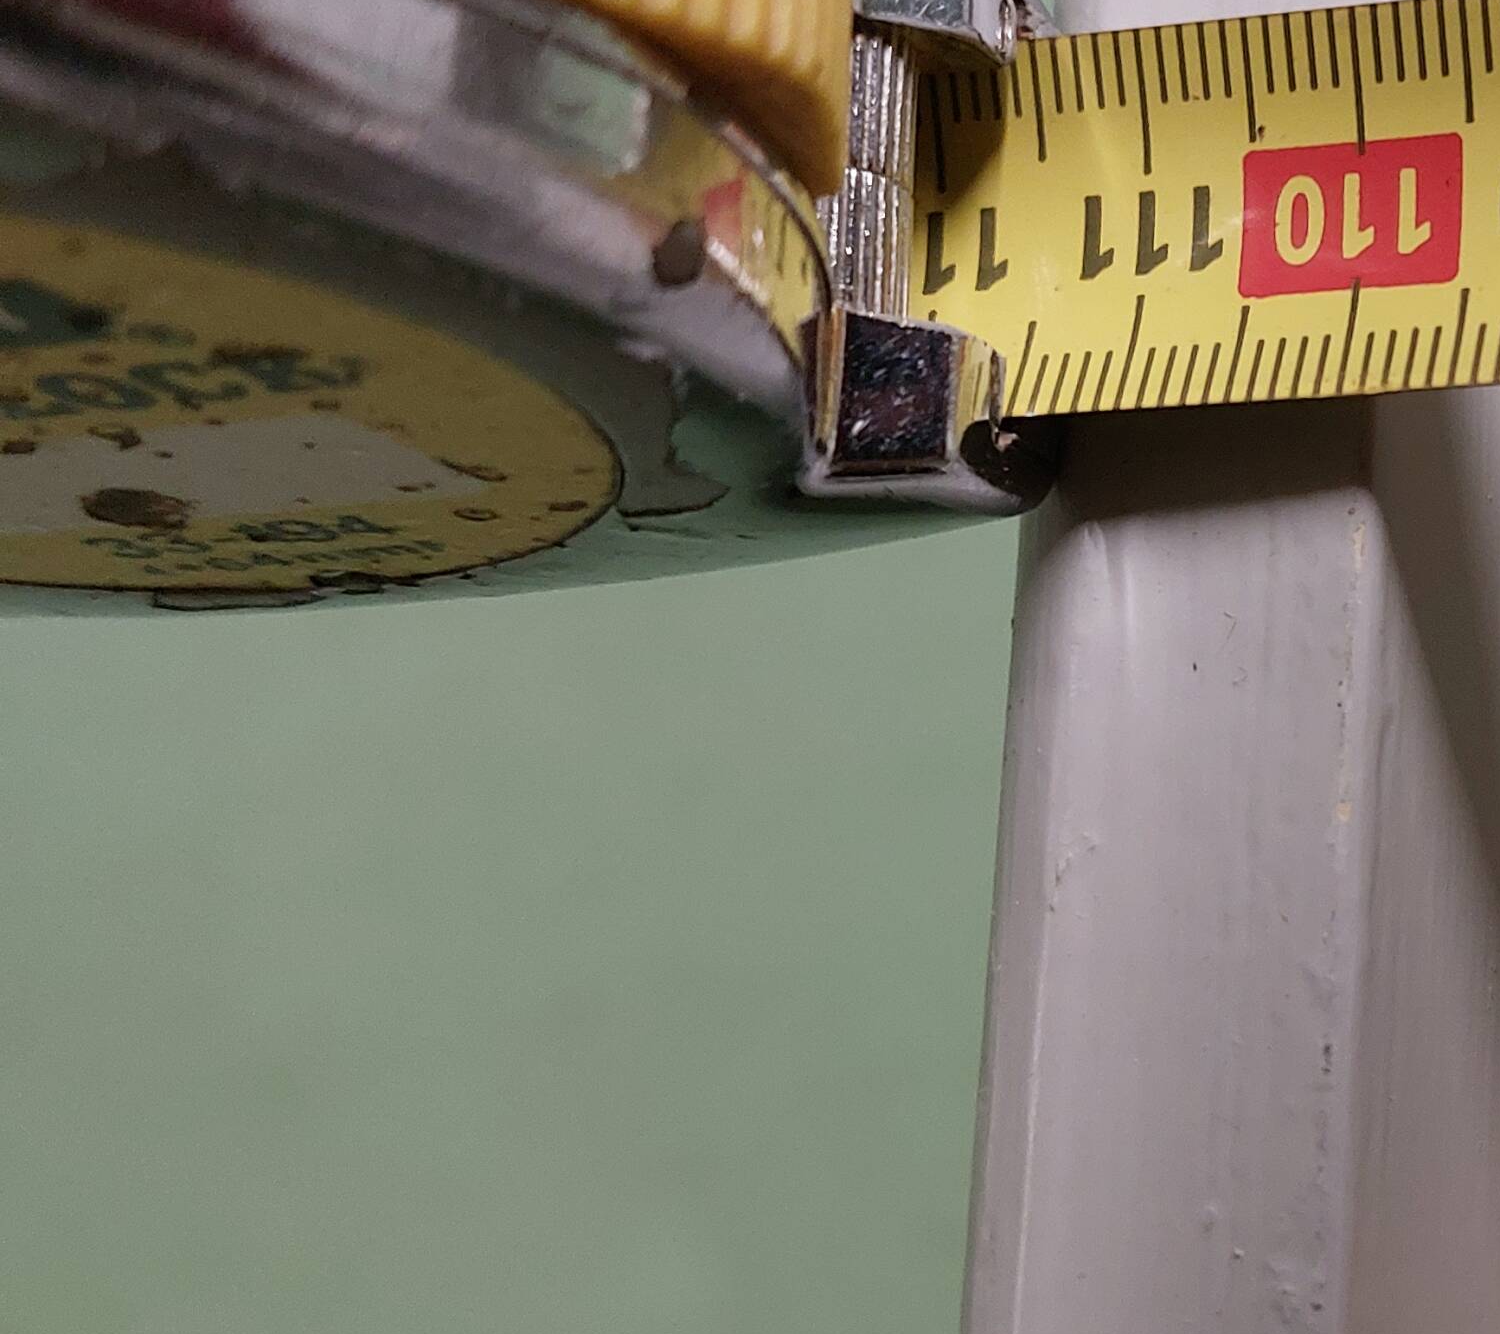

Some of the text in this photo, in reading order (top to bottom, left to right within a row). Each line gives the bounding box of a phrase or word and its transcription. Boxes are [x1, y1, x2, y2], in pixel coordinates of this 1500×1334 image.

[921, 206, 1009, 296] 11
[1079, 184, 1225, 281] 111
[1274, 167, 1433, 266] 110
